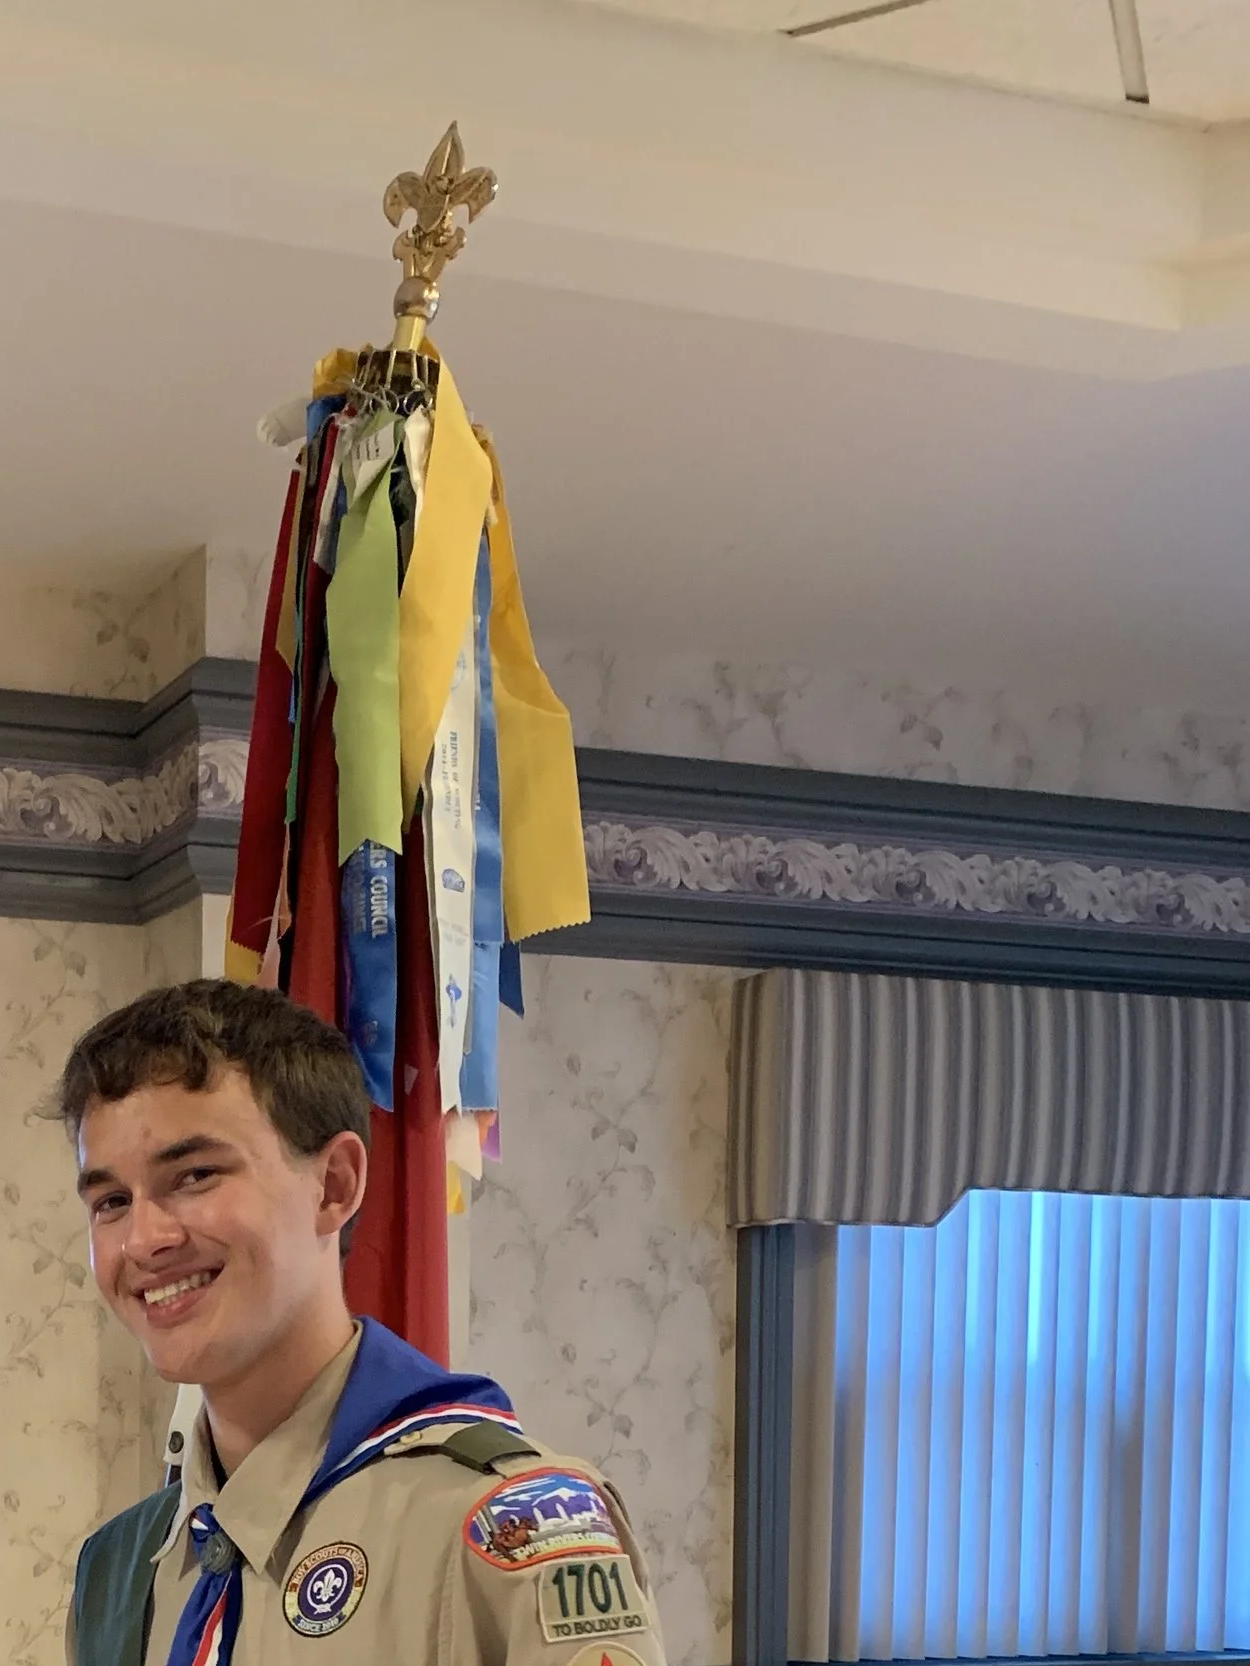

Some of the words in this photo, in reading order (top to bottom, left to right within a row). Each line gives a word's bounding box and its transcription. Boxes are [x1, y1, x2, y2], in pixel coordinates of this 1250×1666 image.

[370, 875, 388, 939] COUNCIL
[306, 1548, 338, 1567] SCOUTS
[552, 1562, 628, 1617] 1701
[552, 1623, 571, 1636] TO
[574, 1616, 620, 1635] BOLDLY
[624, 1615, 642, 1628] GO
